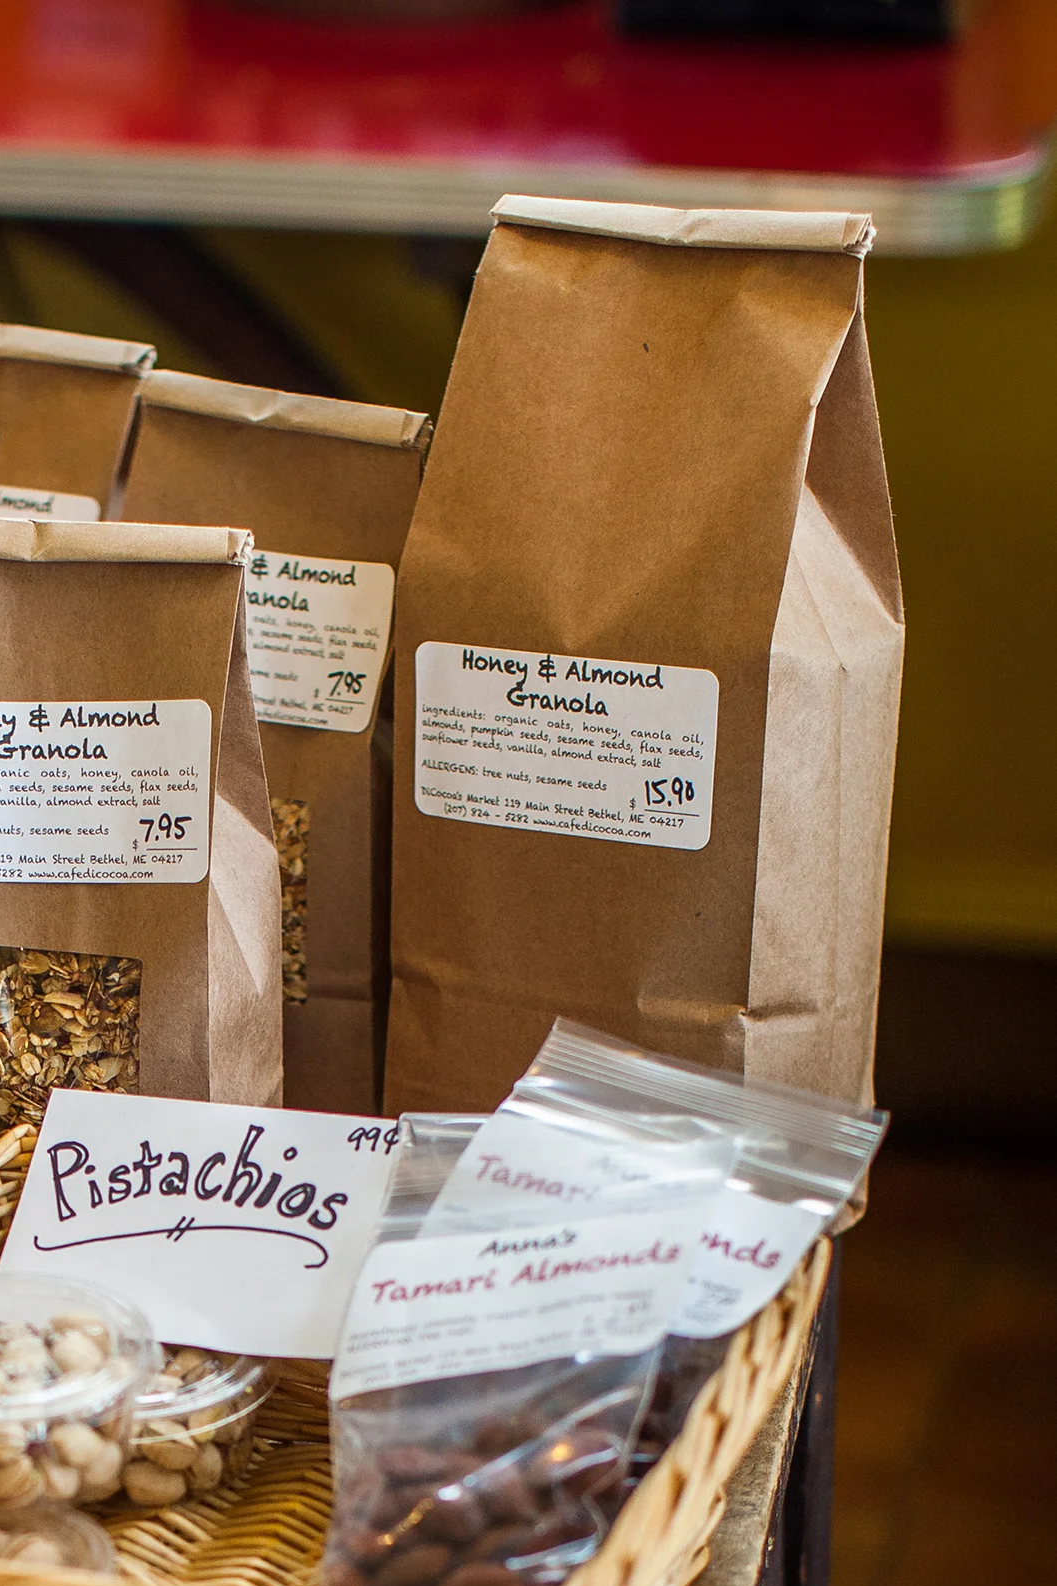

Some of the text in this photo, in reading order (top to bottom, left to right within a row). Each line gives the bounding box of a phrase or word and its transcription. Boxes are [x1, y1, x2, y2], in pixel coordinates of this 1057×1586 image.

[250, 554, 357, 587] & Almond
[246, 590, 310, 612] anola
[328, 670, 367, 697] 7.95
[463, 649, 663, 689] Honey & Almond
[506, 682, 609, 716] Granola
[28, 703, 50, 732] &
[60, 703, 160, 727] Almond
[422, 704, 704, 746] ingredients: organic oats, honey, canola oil,
[422, 719, 703, 760] almonds, pumpkin seeds, sesame seeds, flax seeds,
[422, 732, 661, 768] sunflower seeds, vanilla, almond extract, salt
[9, 782, 45, 794] seeds,
[52, 784, 94, 792] sesame
[101, 782, 134, 793] seeds,
[139, 781, 161, 794] flax
[167, 782, 198, 793] seeds,
[41, 768, 71, 779] oats,
[81, 767, 121, 781] honey,
[130, 767, 170, 778] canola
[179, 766, 199, 778] oil,
[421, 759, 607, 791] ALLERGENS: tree nuts, sesame seeds
[46, 795, 92, 806] almond
[97, 797, 138, 808] extract,
[142, 796, 161, 806] salt
[629, 777, 695, 810] $ 15.90
[444, 802, 467, 817] (207)
[471, 808, 490, 818] 824
[505, 812, 529, 824] 5282
[533, 818, 651, 839] www.cafedicocoa.com
[467, 793, 500, 807] Market
[504, 798, 521, 809] 119
[525, 801, 549, 812] Main
[554, 804, 584, 817] Street
[589, 808, 623, 823] Bethel,
[629, 813, 644, 823] ME
[649, 816, 684, 828] 04217
[29, 826, 72, 835] sesame
[77, 825, 109, 835] seeds
[132, 813, 192, 851] $ 7.95
[19, 853, 46, 864] Main
[52, 853, 85, 864] Street
[90, 853, 128, 865] Bethel,
[133, 854, 146, 864] ME
[152, 854, 183, 864] 04217
[28, 868, 153, 879] www.cafedicocoa.com
[47, 1124, 349, 1230] Pistachios
[475, 1154, 600, 1202] Tamari
[371, 1269, 496, 1305] Tamari
[511, 1241, 682, 1289] Almonds
